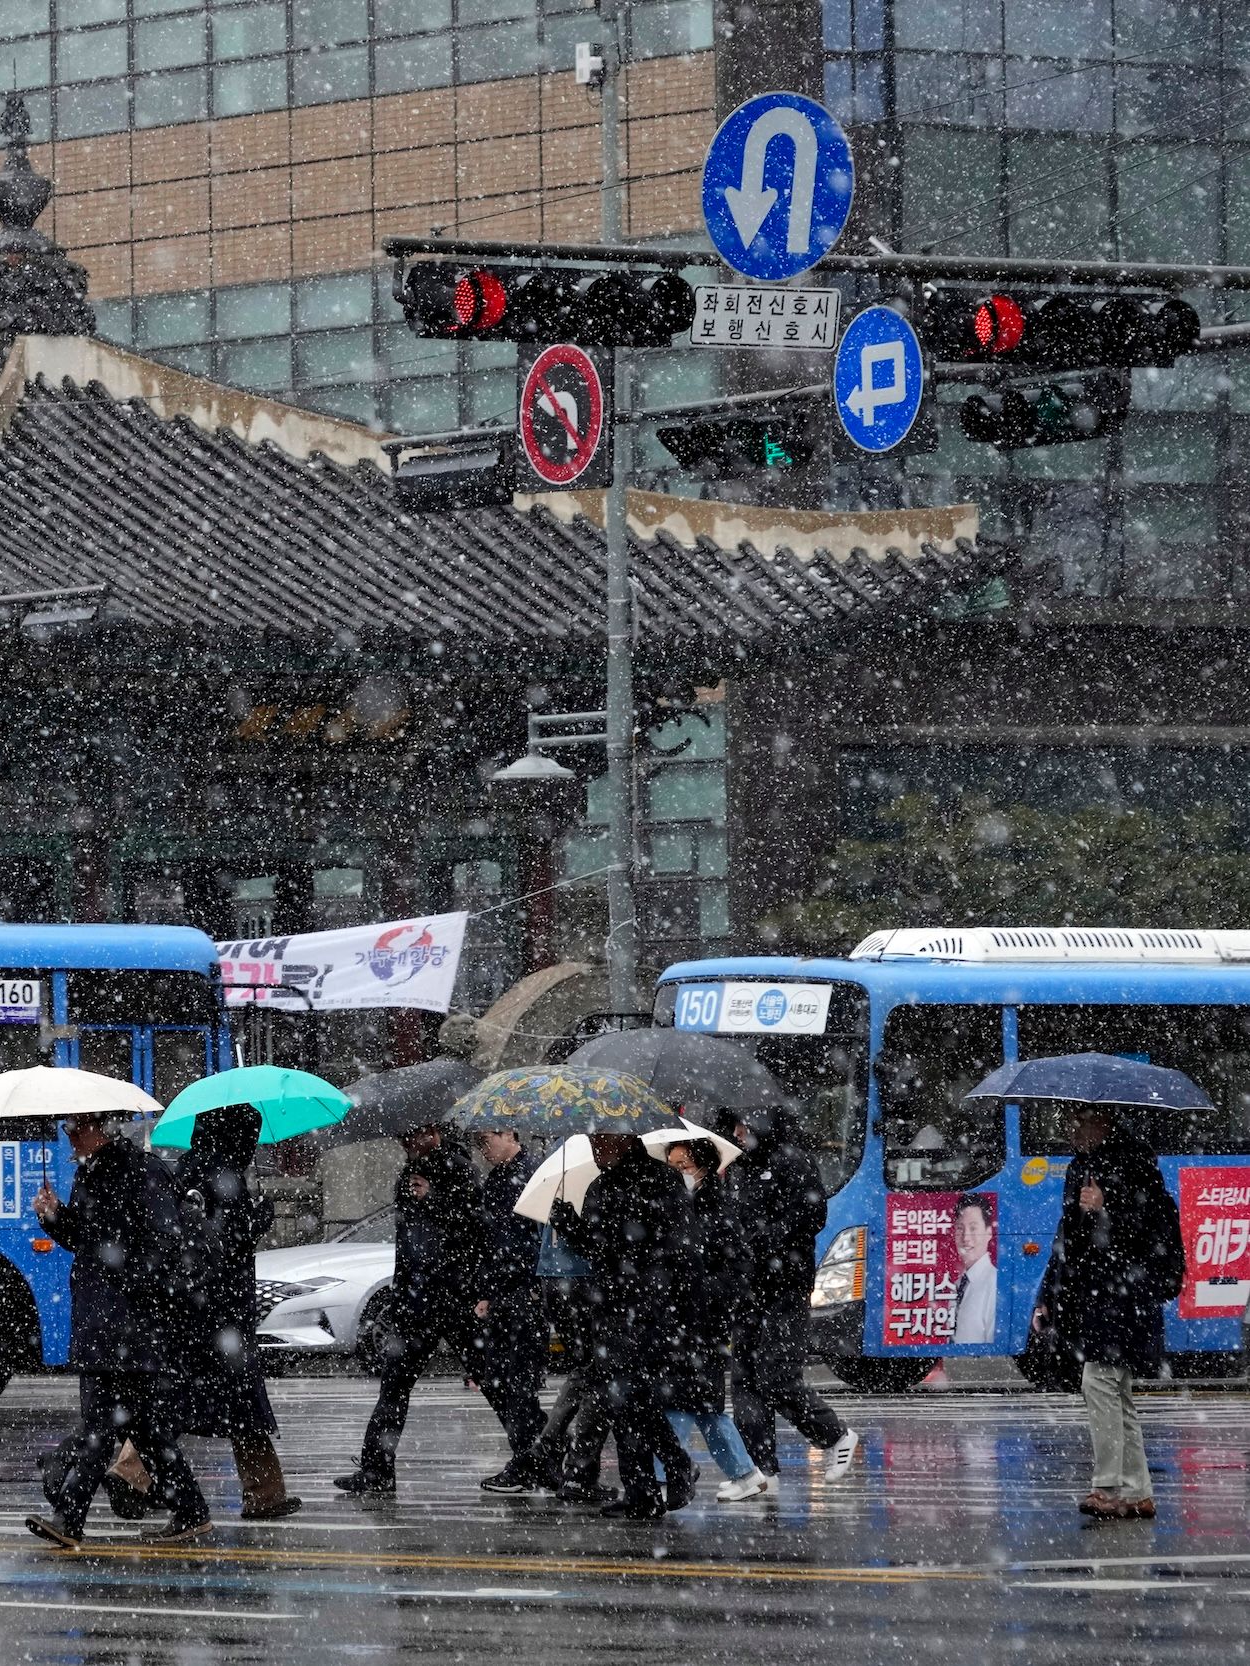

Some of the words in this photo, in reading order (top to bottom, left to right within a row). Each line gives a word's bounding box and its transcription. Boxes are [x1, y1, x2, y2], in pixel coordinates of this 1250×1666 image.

[702, 292, 830, 318] 좌회전신호시
[700, 318, 828, 343] 보행신호시
[680, 990, 718, 1026] 150
[28, 1148, 53, 1164] 160
[892, 1209, 953, 1236] 토익점수
[892, 1240, 938, 1265] 벌크업
[890, 1271, 958, 1302] 해커스
[889, 1307, 958, 1338] 구자연
